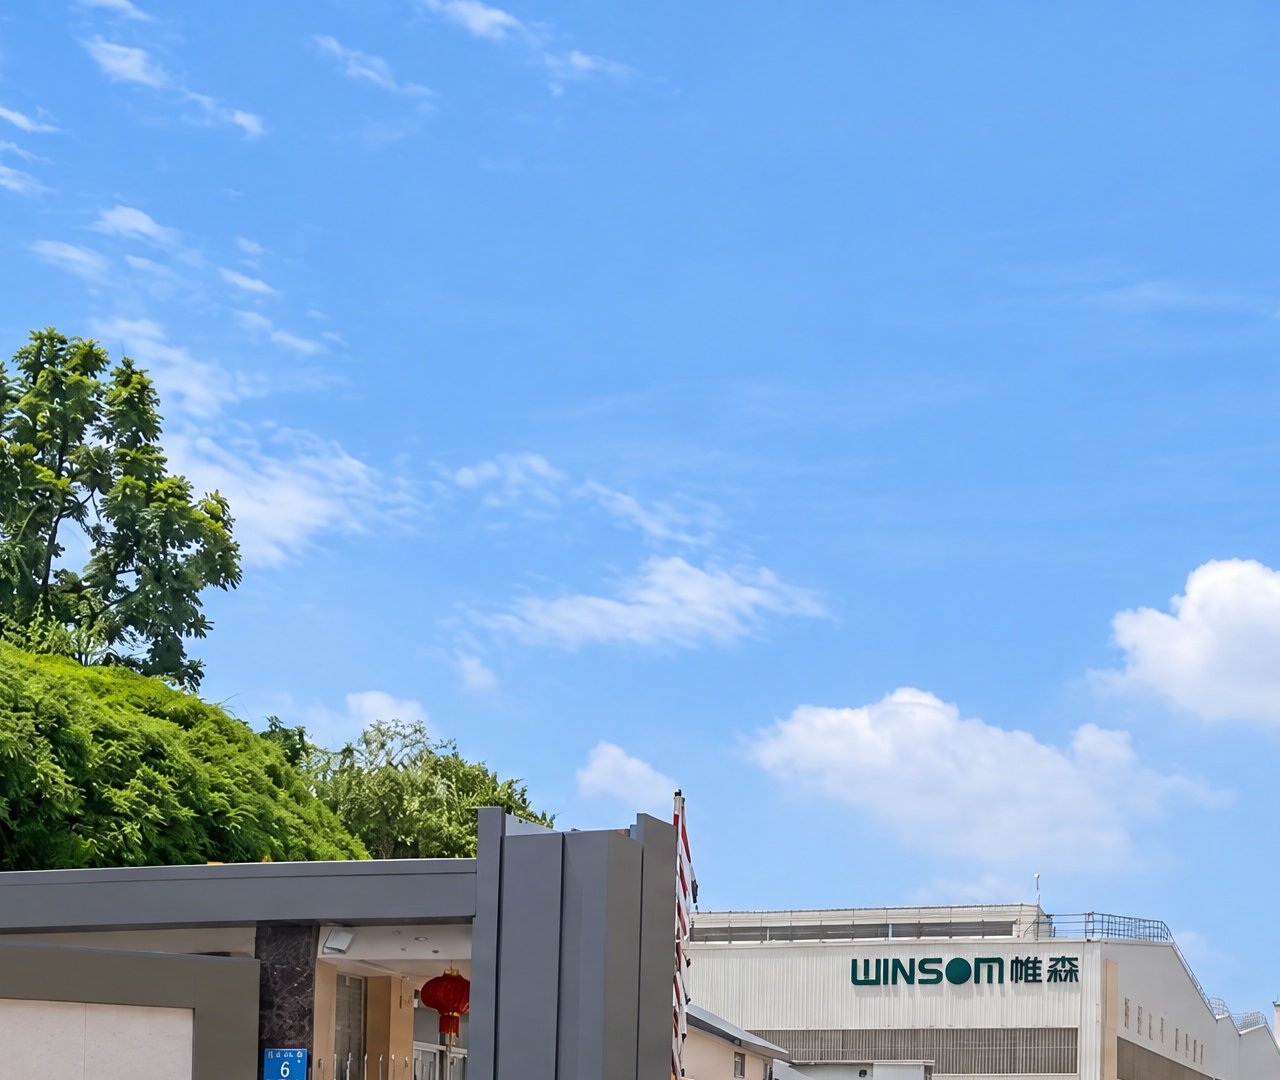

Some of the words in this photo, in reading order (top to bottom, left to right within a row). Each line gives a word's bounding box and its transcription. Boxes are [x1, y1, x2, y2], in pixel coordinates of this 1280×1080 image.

[851, 957, 1004, 985] WINSOM
[1010, 956, 1080, 983] 帷森
[280, 1061, 290, 1078] 6
